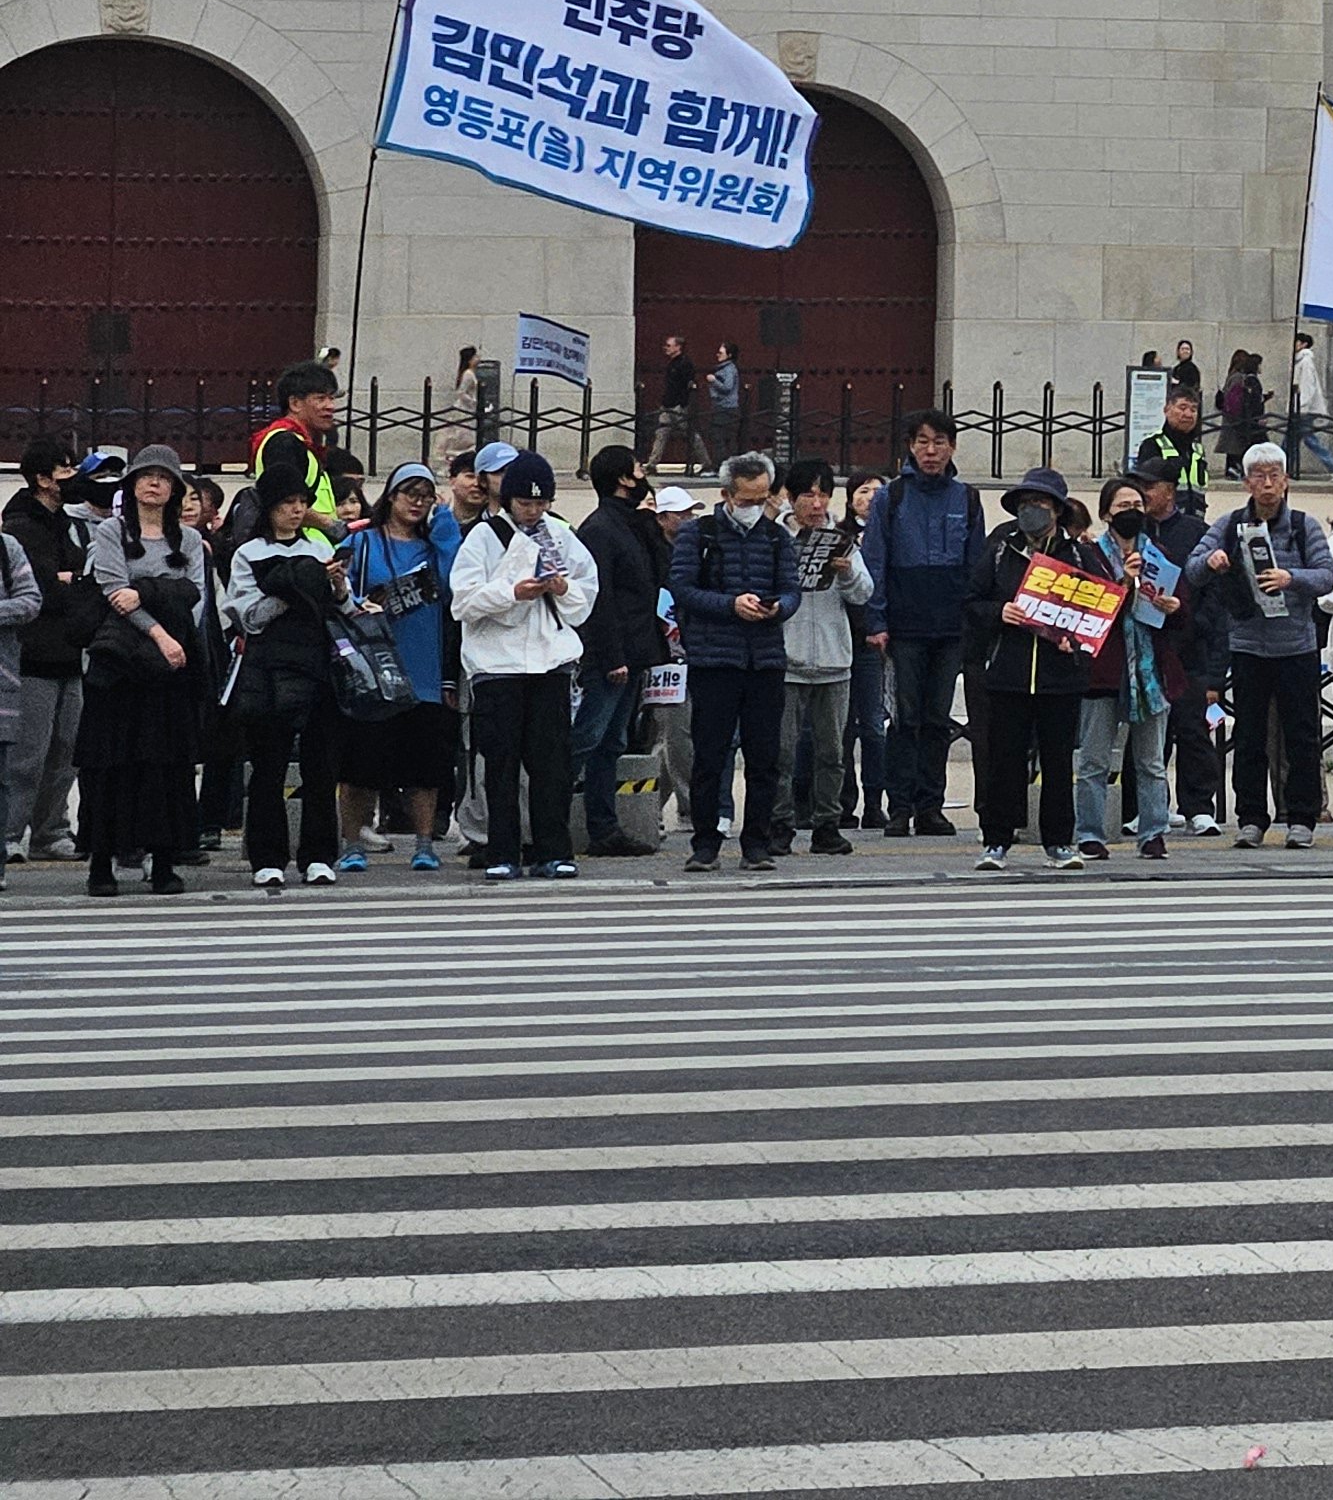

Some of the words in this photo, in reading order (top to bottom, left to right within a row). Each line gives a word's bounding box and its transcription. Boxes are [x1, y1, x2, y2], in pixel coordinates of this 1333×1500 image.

[431, 15, 650, 137] 김민석과
[664, 89, 801, 170] 함께!
[423, 85, 584, 173] 영등포(을)
[595, 146, 790, 224] 지역위원회
[1016, 593, 1112, 639] 파면하라!
[1023, 566, 1121, 615] 윤석열을
